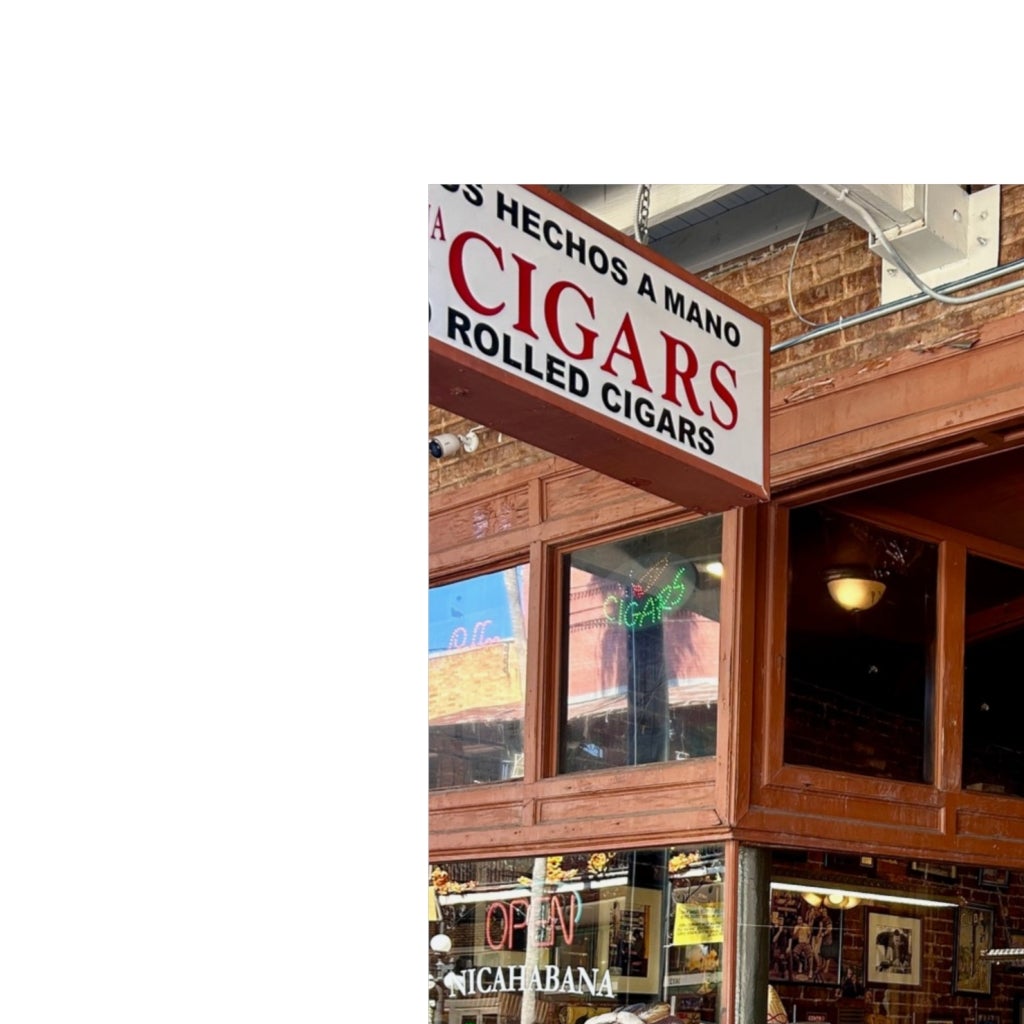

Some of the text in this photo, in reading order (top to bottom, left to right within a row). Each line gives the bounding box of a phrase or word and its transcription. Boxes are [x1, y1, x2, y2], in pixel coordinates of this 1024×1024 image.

[496, 191, 629, 286] HECHOS
[637, 273, 658, 304] A
[664, 286, 742, 348] MANO
[447, 230, 740, 431] CIGARS
[447, 306, 716, 457] ROLLED CIGARS
[603, 566, 686, 628] CIGARS
[486, 893, 576, 951] OPEN
[448, 964, 619, 999] NICAHABANA
